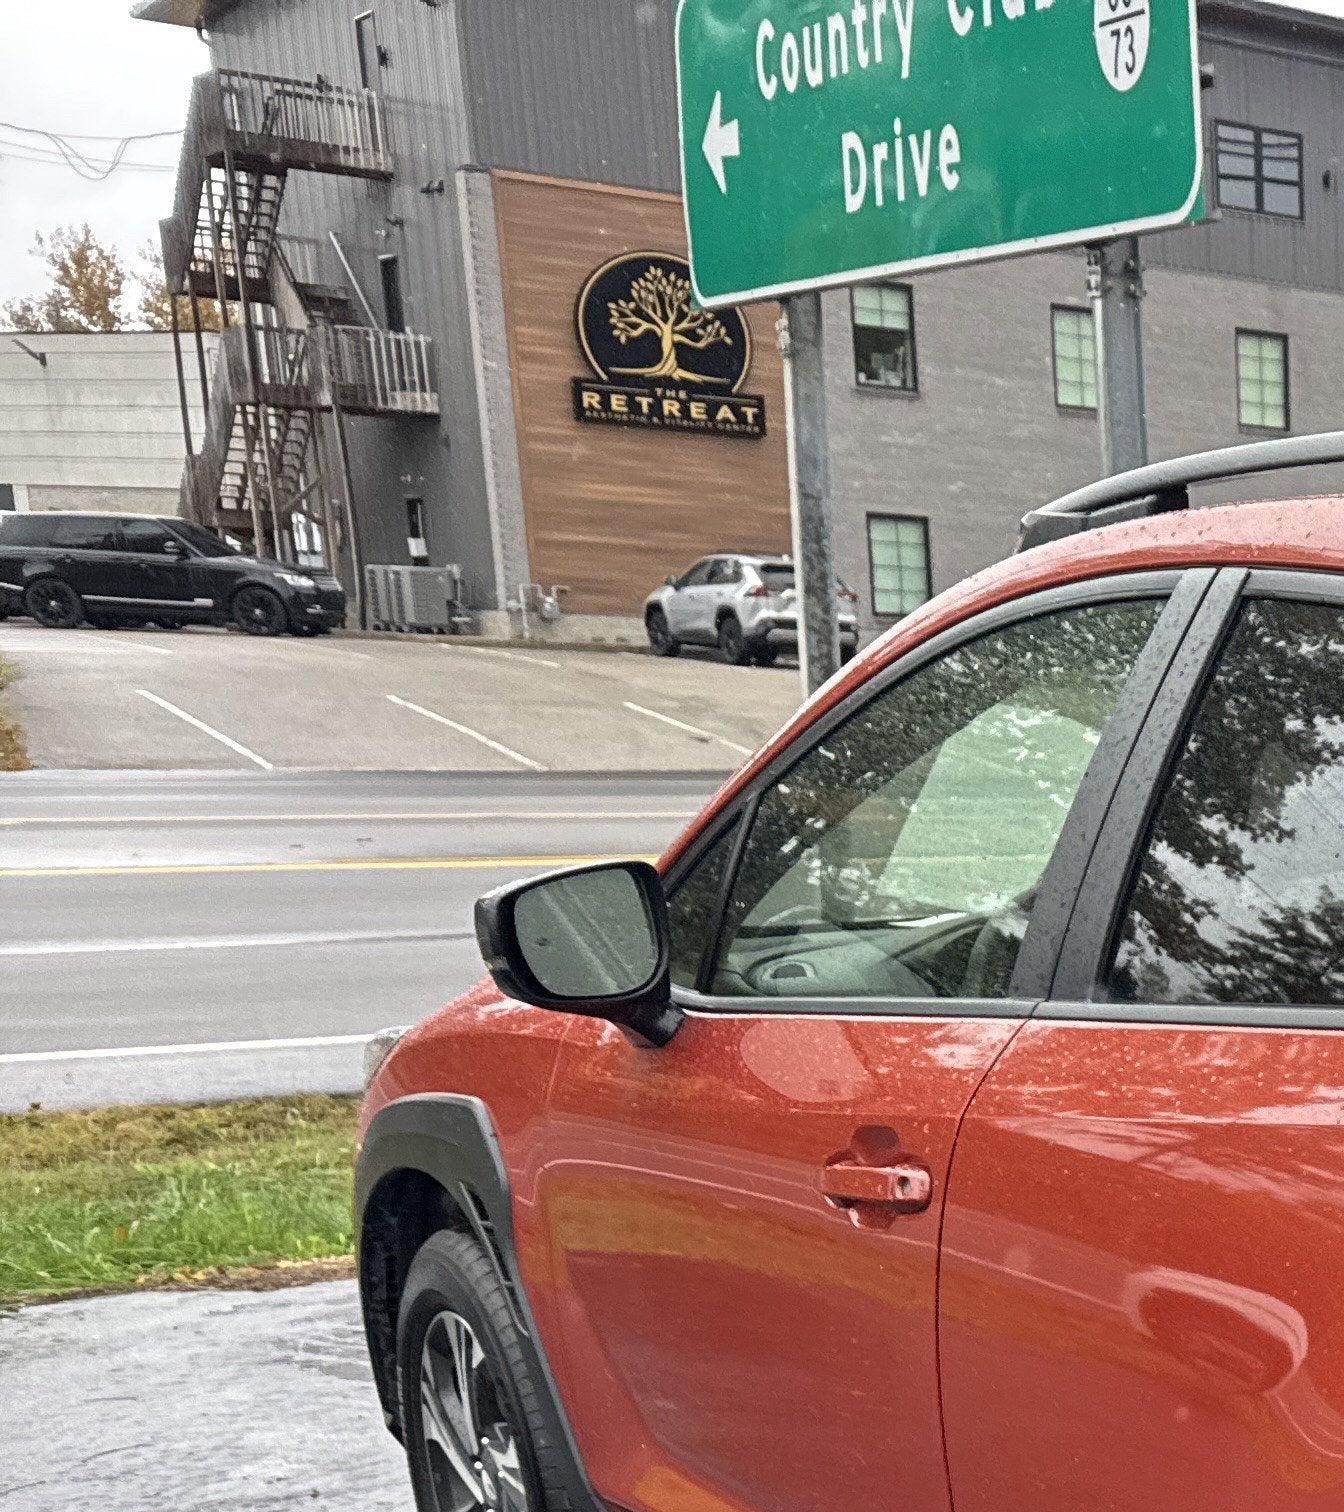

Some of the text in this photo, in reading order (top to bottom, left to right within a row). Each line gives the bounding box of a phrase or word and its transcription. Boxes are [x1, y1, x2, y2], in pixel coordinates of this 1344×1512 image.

[756, 0, 914, 100] Country
[1109, 24, 1137, 79] 73
[842, 117, 962, 214] Drive
[581, 390, 760, 425] RETREAT
[654, 386, 688, 400] THE
